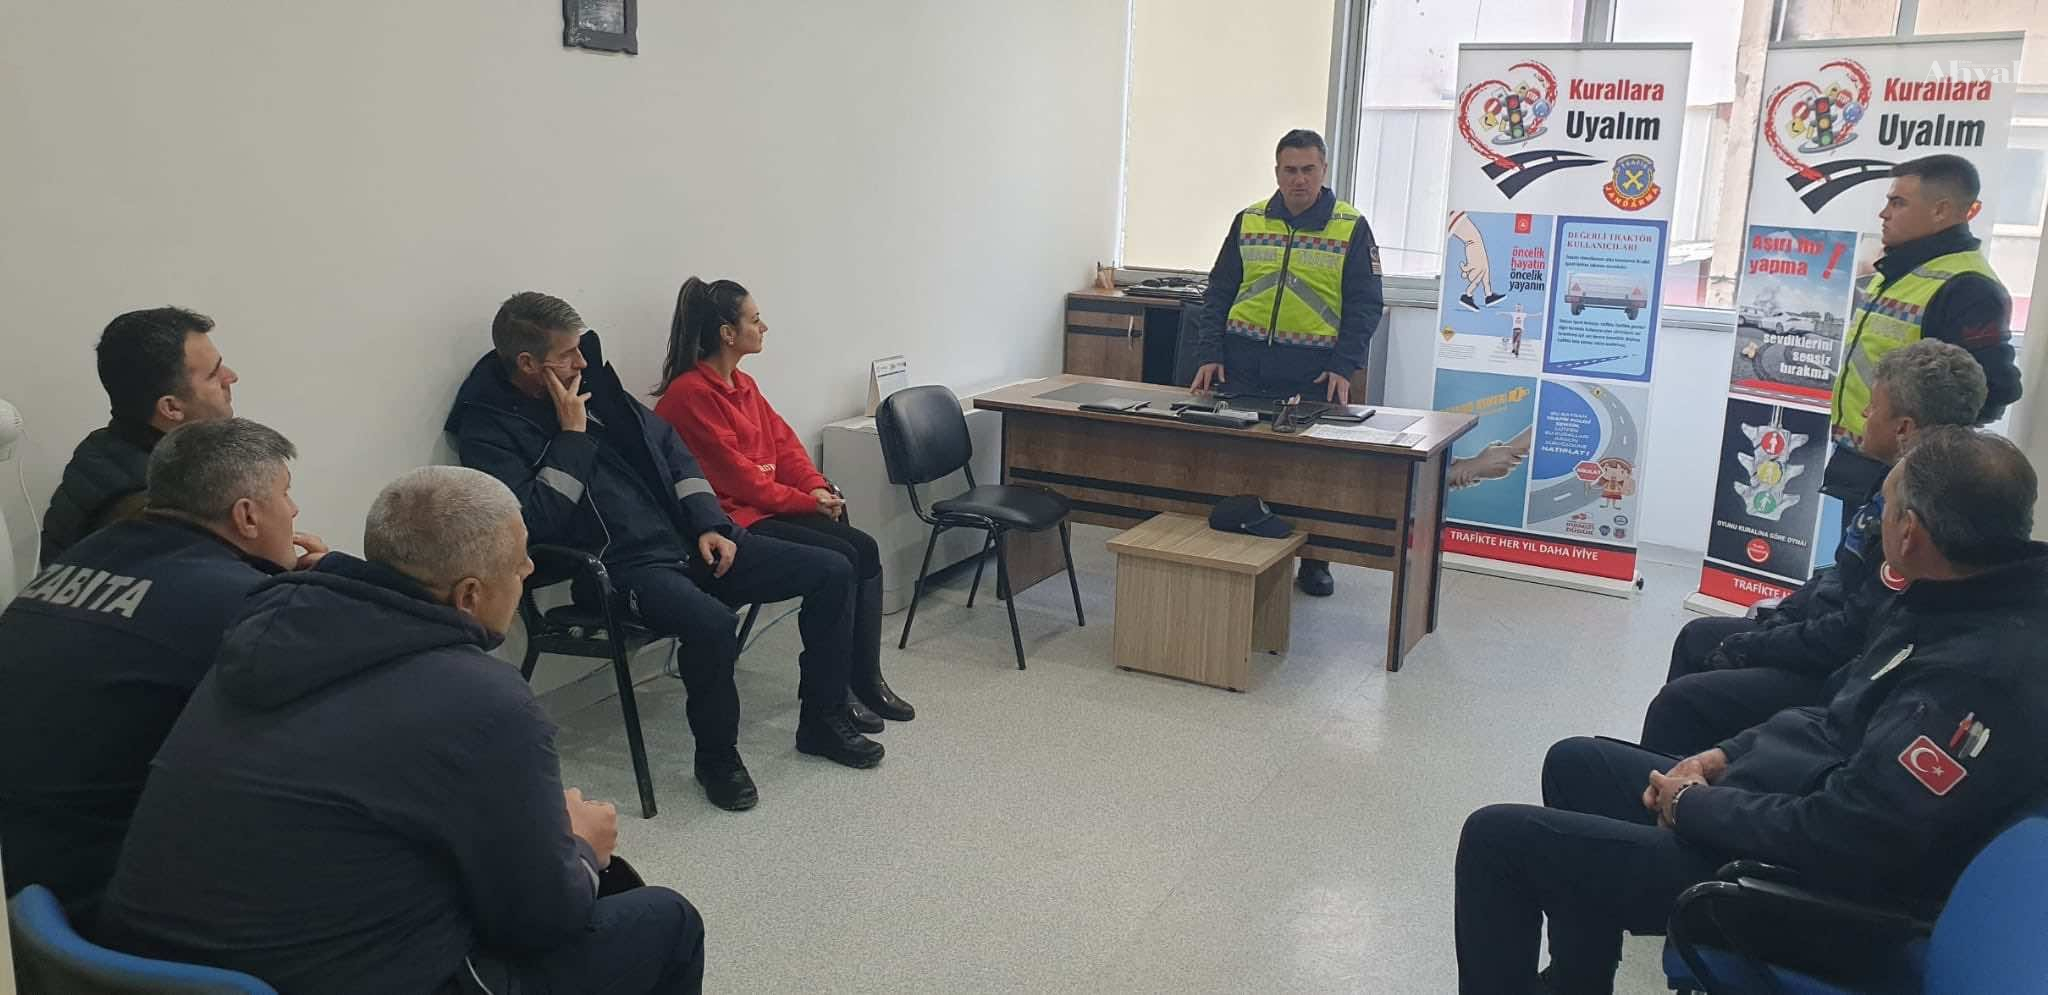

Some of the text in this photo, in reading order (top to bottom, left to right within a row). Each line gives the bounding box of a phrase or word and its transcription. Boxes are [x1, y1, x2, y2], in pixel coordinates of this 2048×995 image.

[1569, 79, 1664, 101] Kurallara
[1884, 77, 1992, 102] Kurallara
[1566, 111, 1660, 142] Uyalım
[1878, 113, 1985, 150] Uyalım
[1512, 246, 1544, 258] öncelik
[1511, 257, 1545, 270] hayatın
[1749, 258, 1808, 276] yapma
[1510, 269, 1542, 280] öncelik
[1509, 280, 1545, 292] yayanın
[1763, 334, 1833, 351] sevdiklerini
[1792, 351, 1832, 365] sensiz
[1780, 362, 1829, 380] bırakma
[1717, 520, 1738, 530] OYUNU
[1451, 530, 1599, 561] TRAFİKTE HER YIL DAHA İYİYE
[17, 564, 152, 618] ZABITA
[1733, 578, 1780, 598] TRAFİKTE
